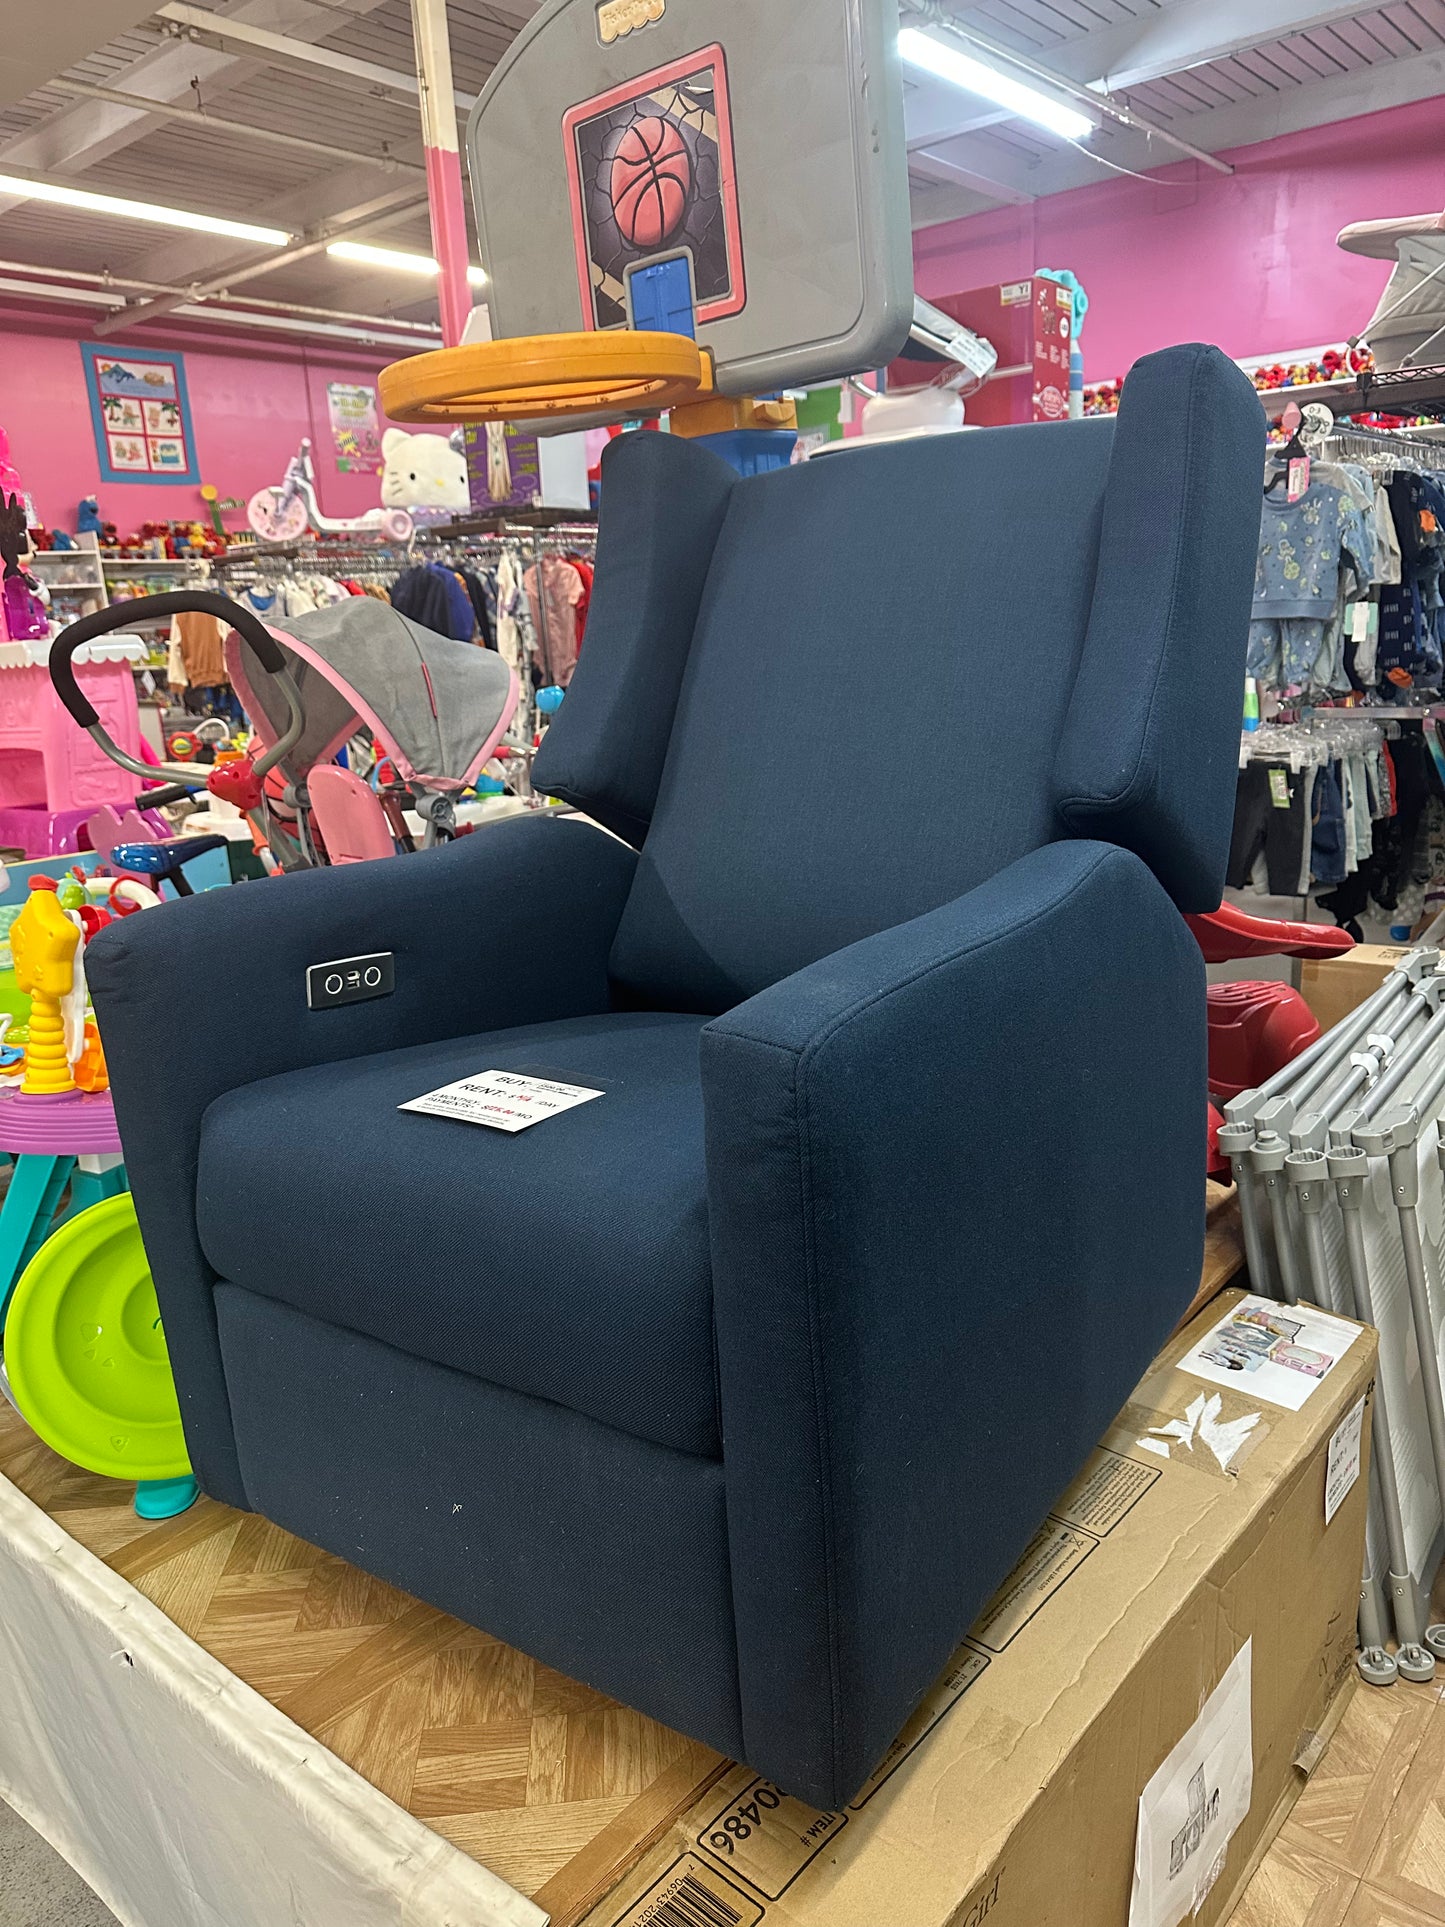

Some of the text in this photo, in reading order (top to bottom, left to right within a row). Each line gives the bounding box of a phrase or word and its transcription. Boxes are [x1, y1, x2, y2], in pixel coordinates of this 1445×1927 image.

[459, 1083, 506, 1099] RENT:
[806, 1812, 837, 1839] ITEM
[656, 1877, 684, 1906] 06943
